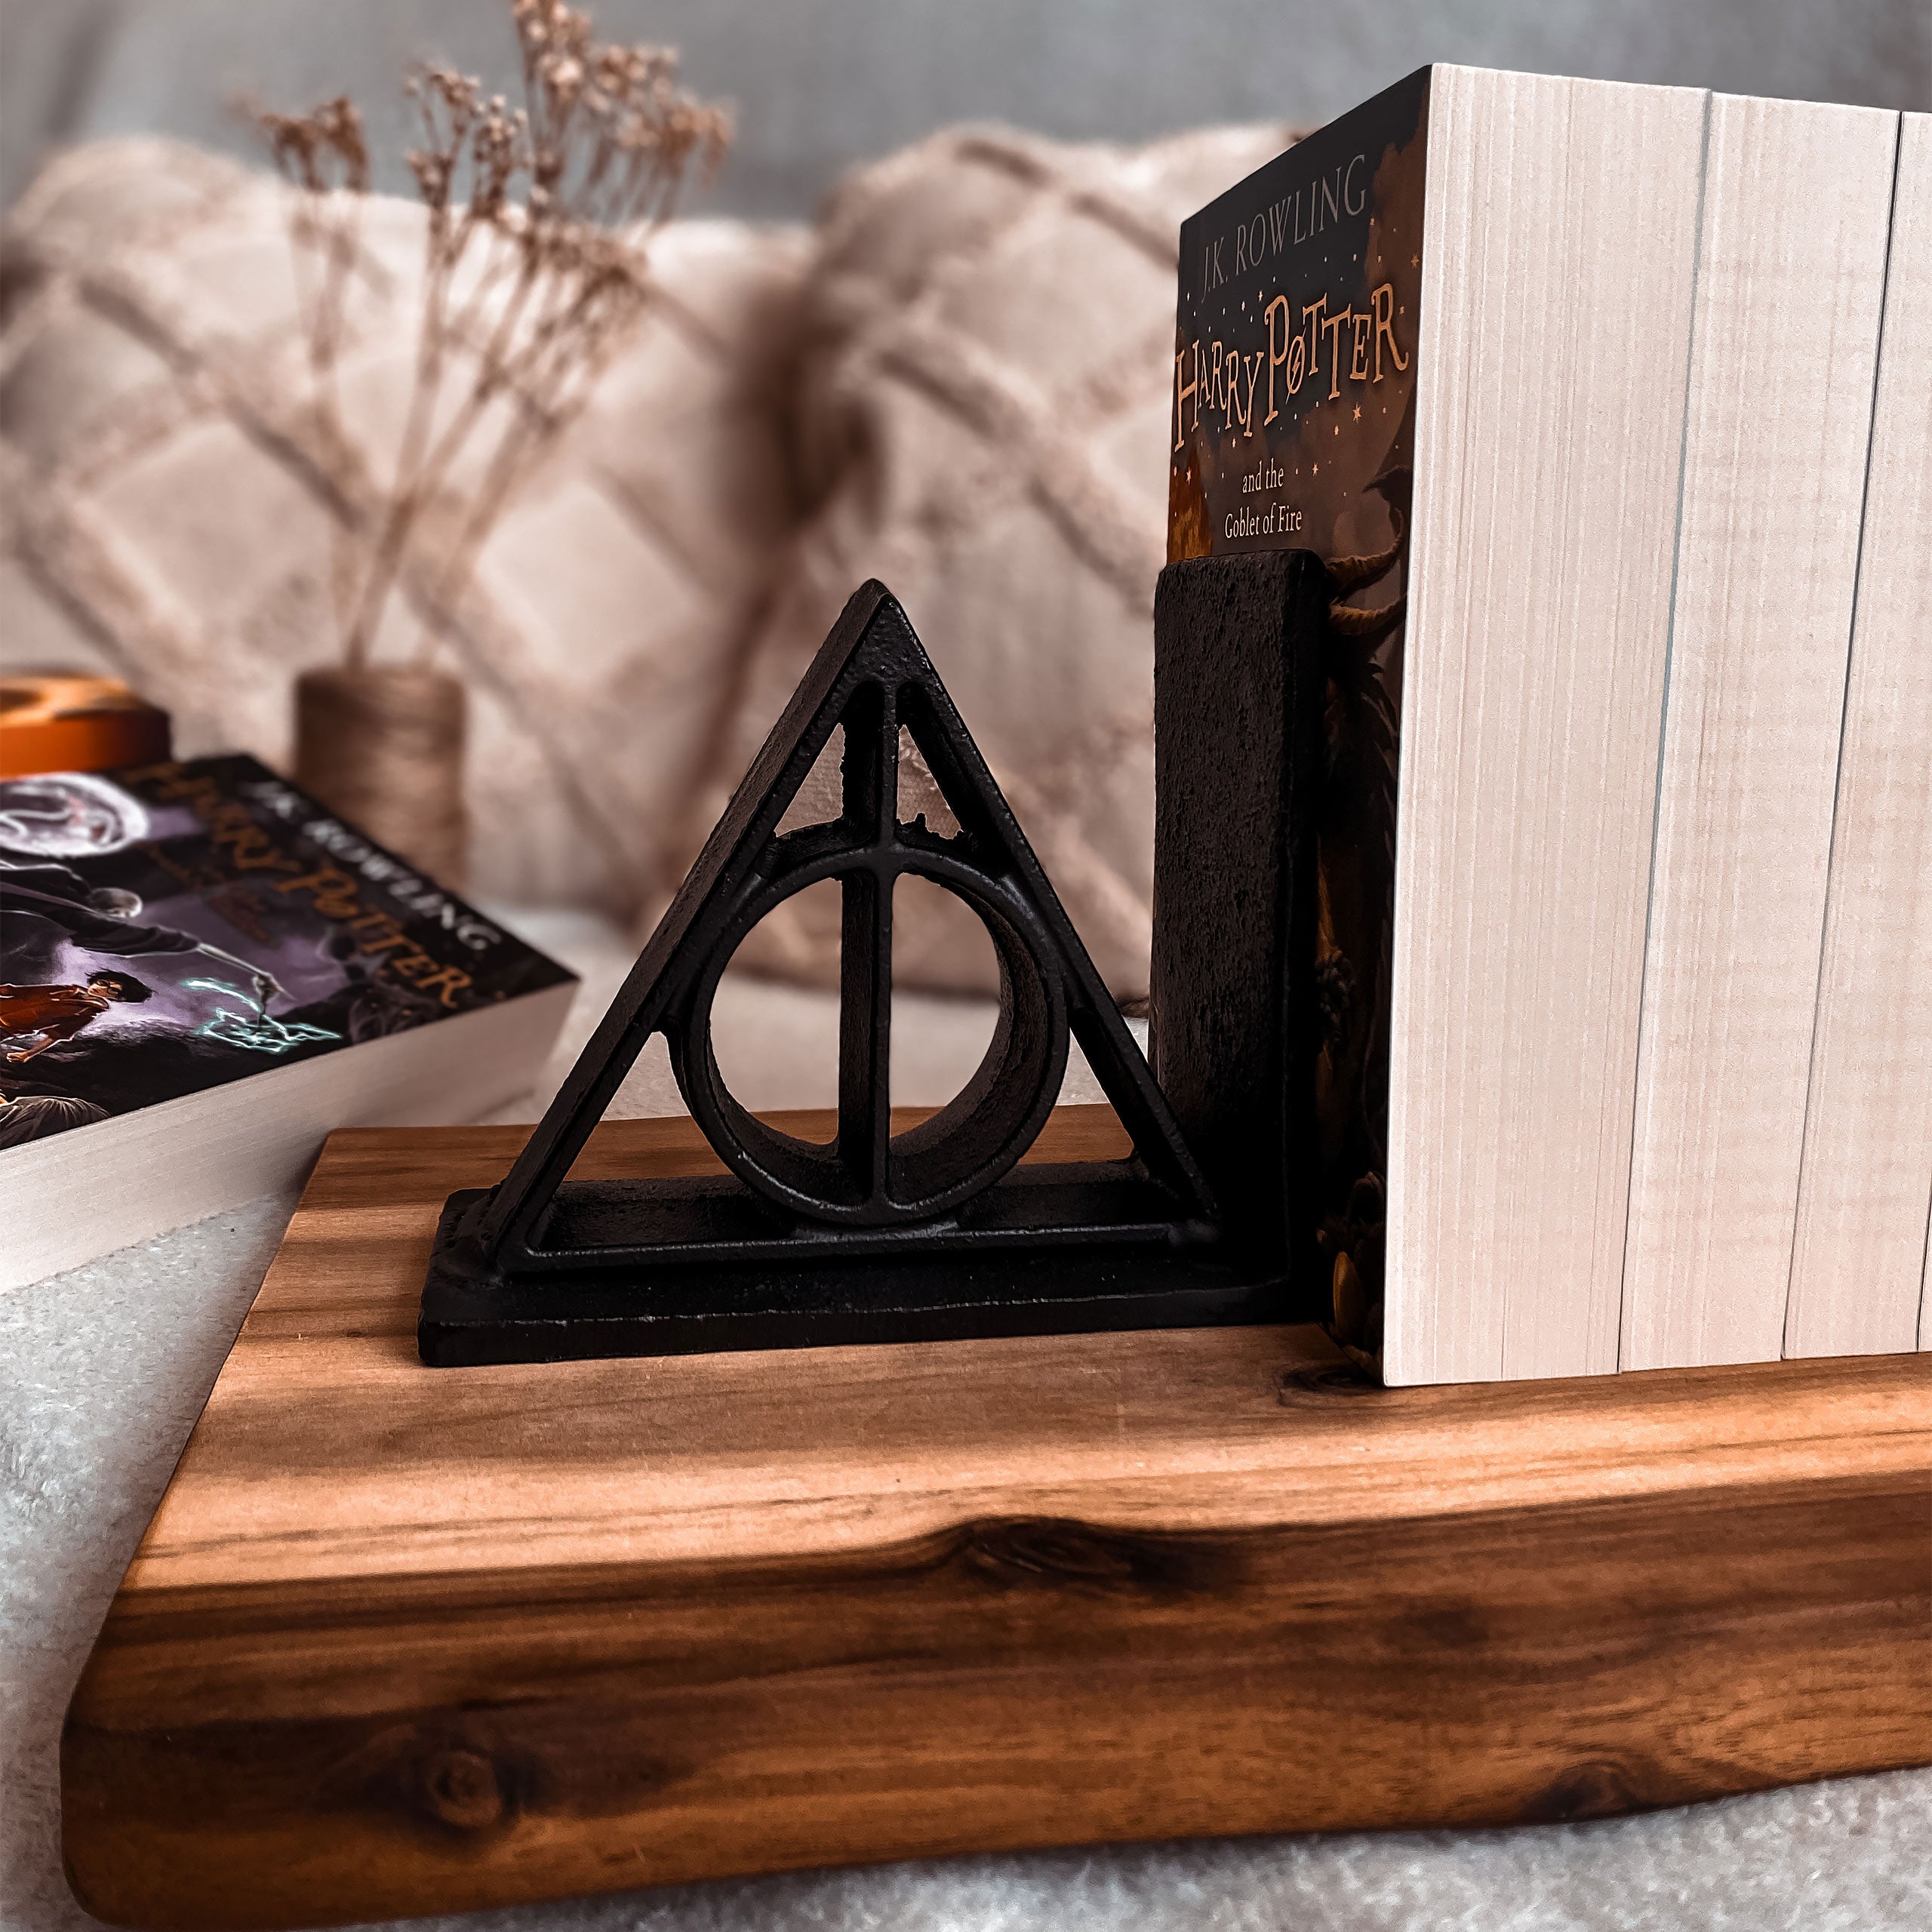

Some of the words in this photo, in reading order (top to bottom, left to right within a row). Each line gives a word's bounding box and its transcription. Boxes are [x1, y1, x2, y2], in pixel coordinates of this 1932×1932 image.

[1201, 236, 1229, 304] J.K.
[1235, 154, 1367, 277] ROWLING
[1174, 339, 1265, 453] HARRY
[1264, 282, 1410, 426] POTTER
[1225, 506, 1260, 539] Goblet
[1263, 502, 1277, 534] of
[1277, 504, 1303, 533] Fire
[1242, 460, 1263, 494] and
[1265, 457, 1284, 490] the
[275, 867, 475, 1008] POTTER
